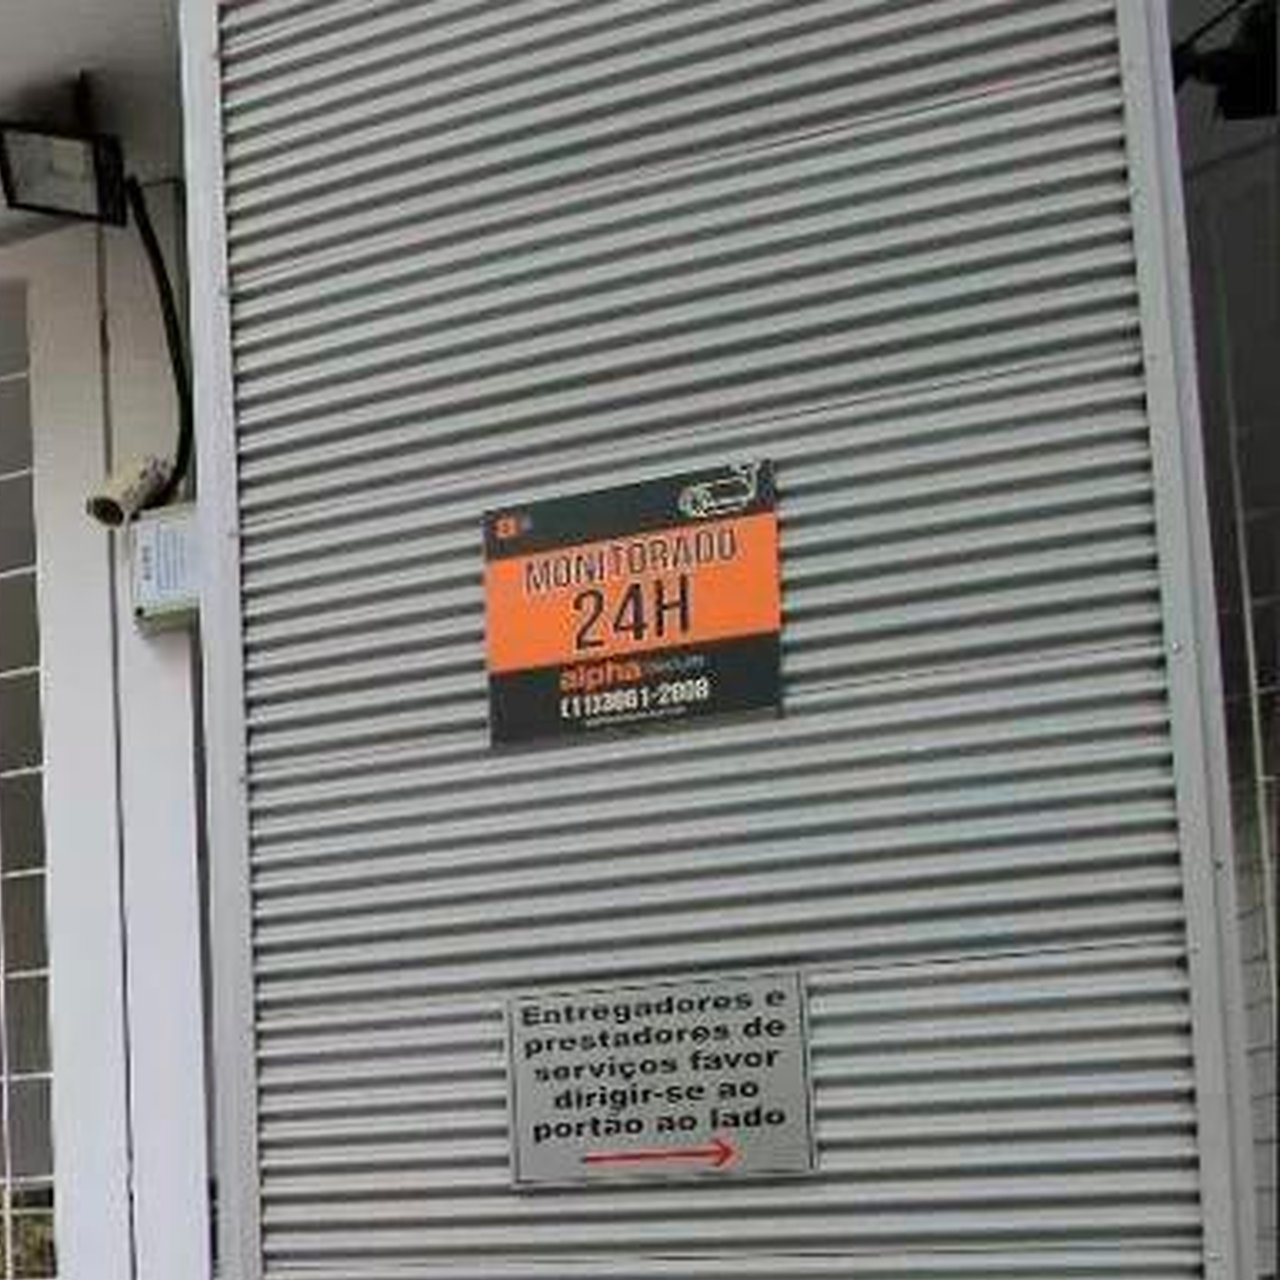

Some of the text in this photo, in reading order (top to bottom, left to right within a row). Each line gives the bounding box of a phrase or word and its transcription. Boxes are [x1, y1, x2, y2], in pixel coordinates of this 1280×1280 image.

[524, 528, 737, 594] MONITORADO
[572, 574, 690, 651] 24H
[560, 659, 640, 692] alpha
[521, 989, 787, 1027] Entregadores e
[524, 1016, 787, 1059] prestadores de
[534, 1049, 781, 1082] serviços favor
[553, 1080, 760, 1113] dirigir-se ao
[533, 1105, 787, 1144] portão ao lado
